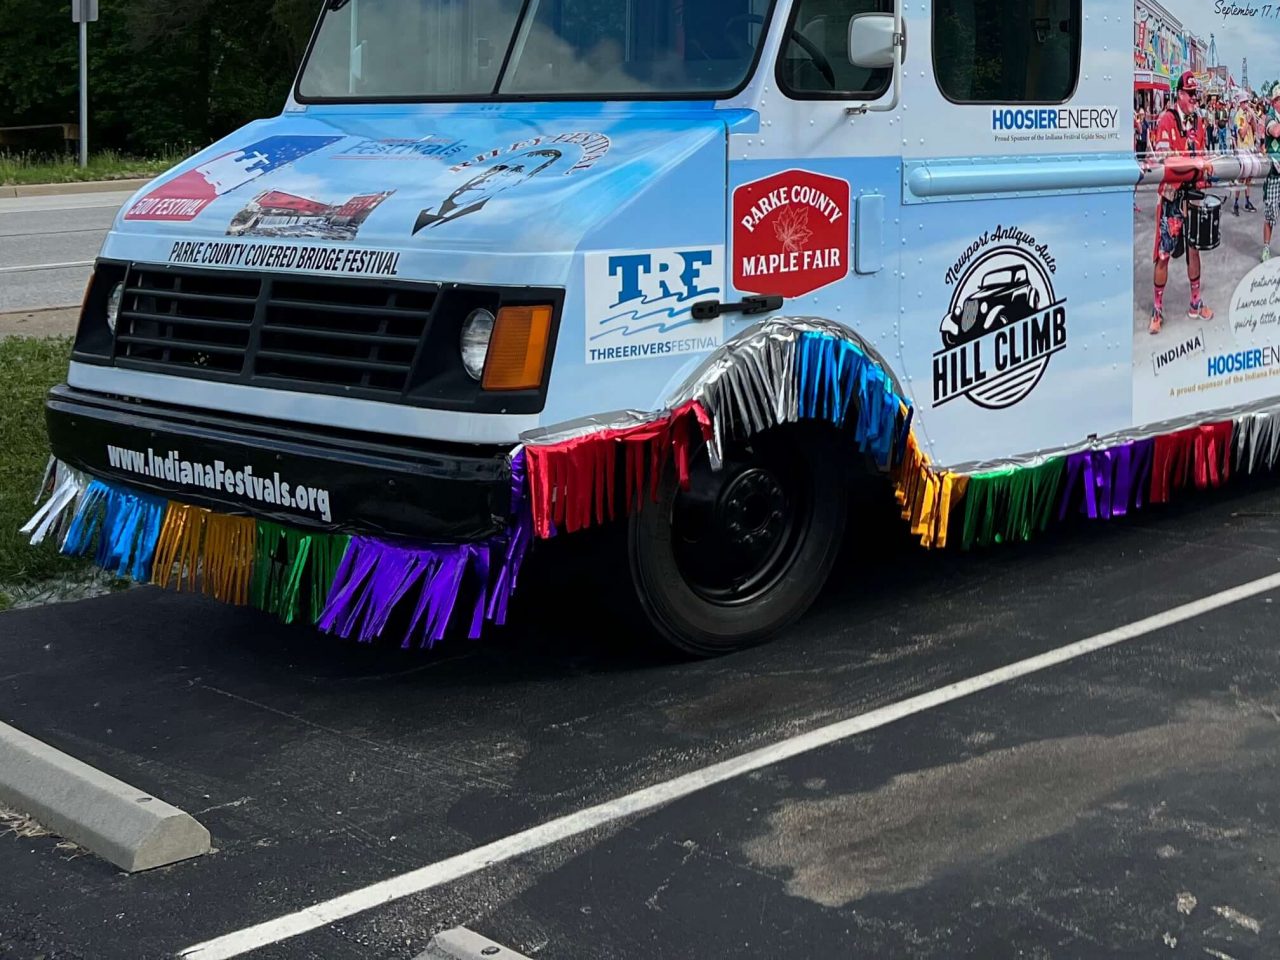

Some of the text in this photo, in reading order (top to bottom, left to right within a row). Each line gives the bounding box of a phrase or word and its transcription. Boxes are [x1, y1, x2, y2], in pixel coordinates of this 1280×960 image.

[1214, 0, 1258, 19] September
[149, 198, 207, 216] FESTIVAL
[741, 185, 842, 233] PARKE COUNTY
[168, 241, 400, 275] PARKE COUNTY COVERED BRIDGE FESTIVAL
[742, 248, 840, 277] MAPLE FAIR
[945, 224, 1056, 285] Newport Antique Auto
[608, 250, 712, 304] TRF
[1250, 275, 1280, 293] featuring
[933, 306, 1067, 402] HILL CLIMB
[1156, 336, 1202, 369] INDIANA
[1170, 388, 1176, 396] A
[1177, 384, 1196, 397] proud
[1197, 380, 1223, 394] sponsor
[1224, 377, 1232, 385] of
[1233, 374, 1244, 384] the
[1244, 372, 1268, 382] Indiana
